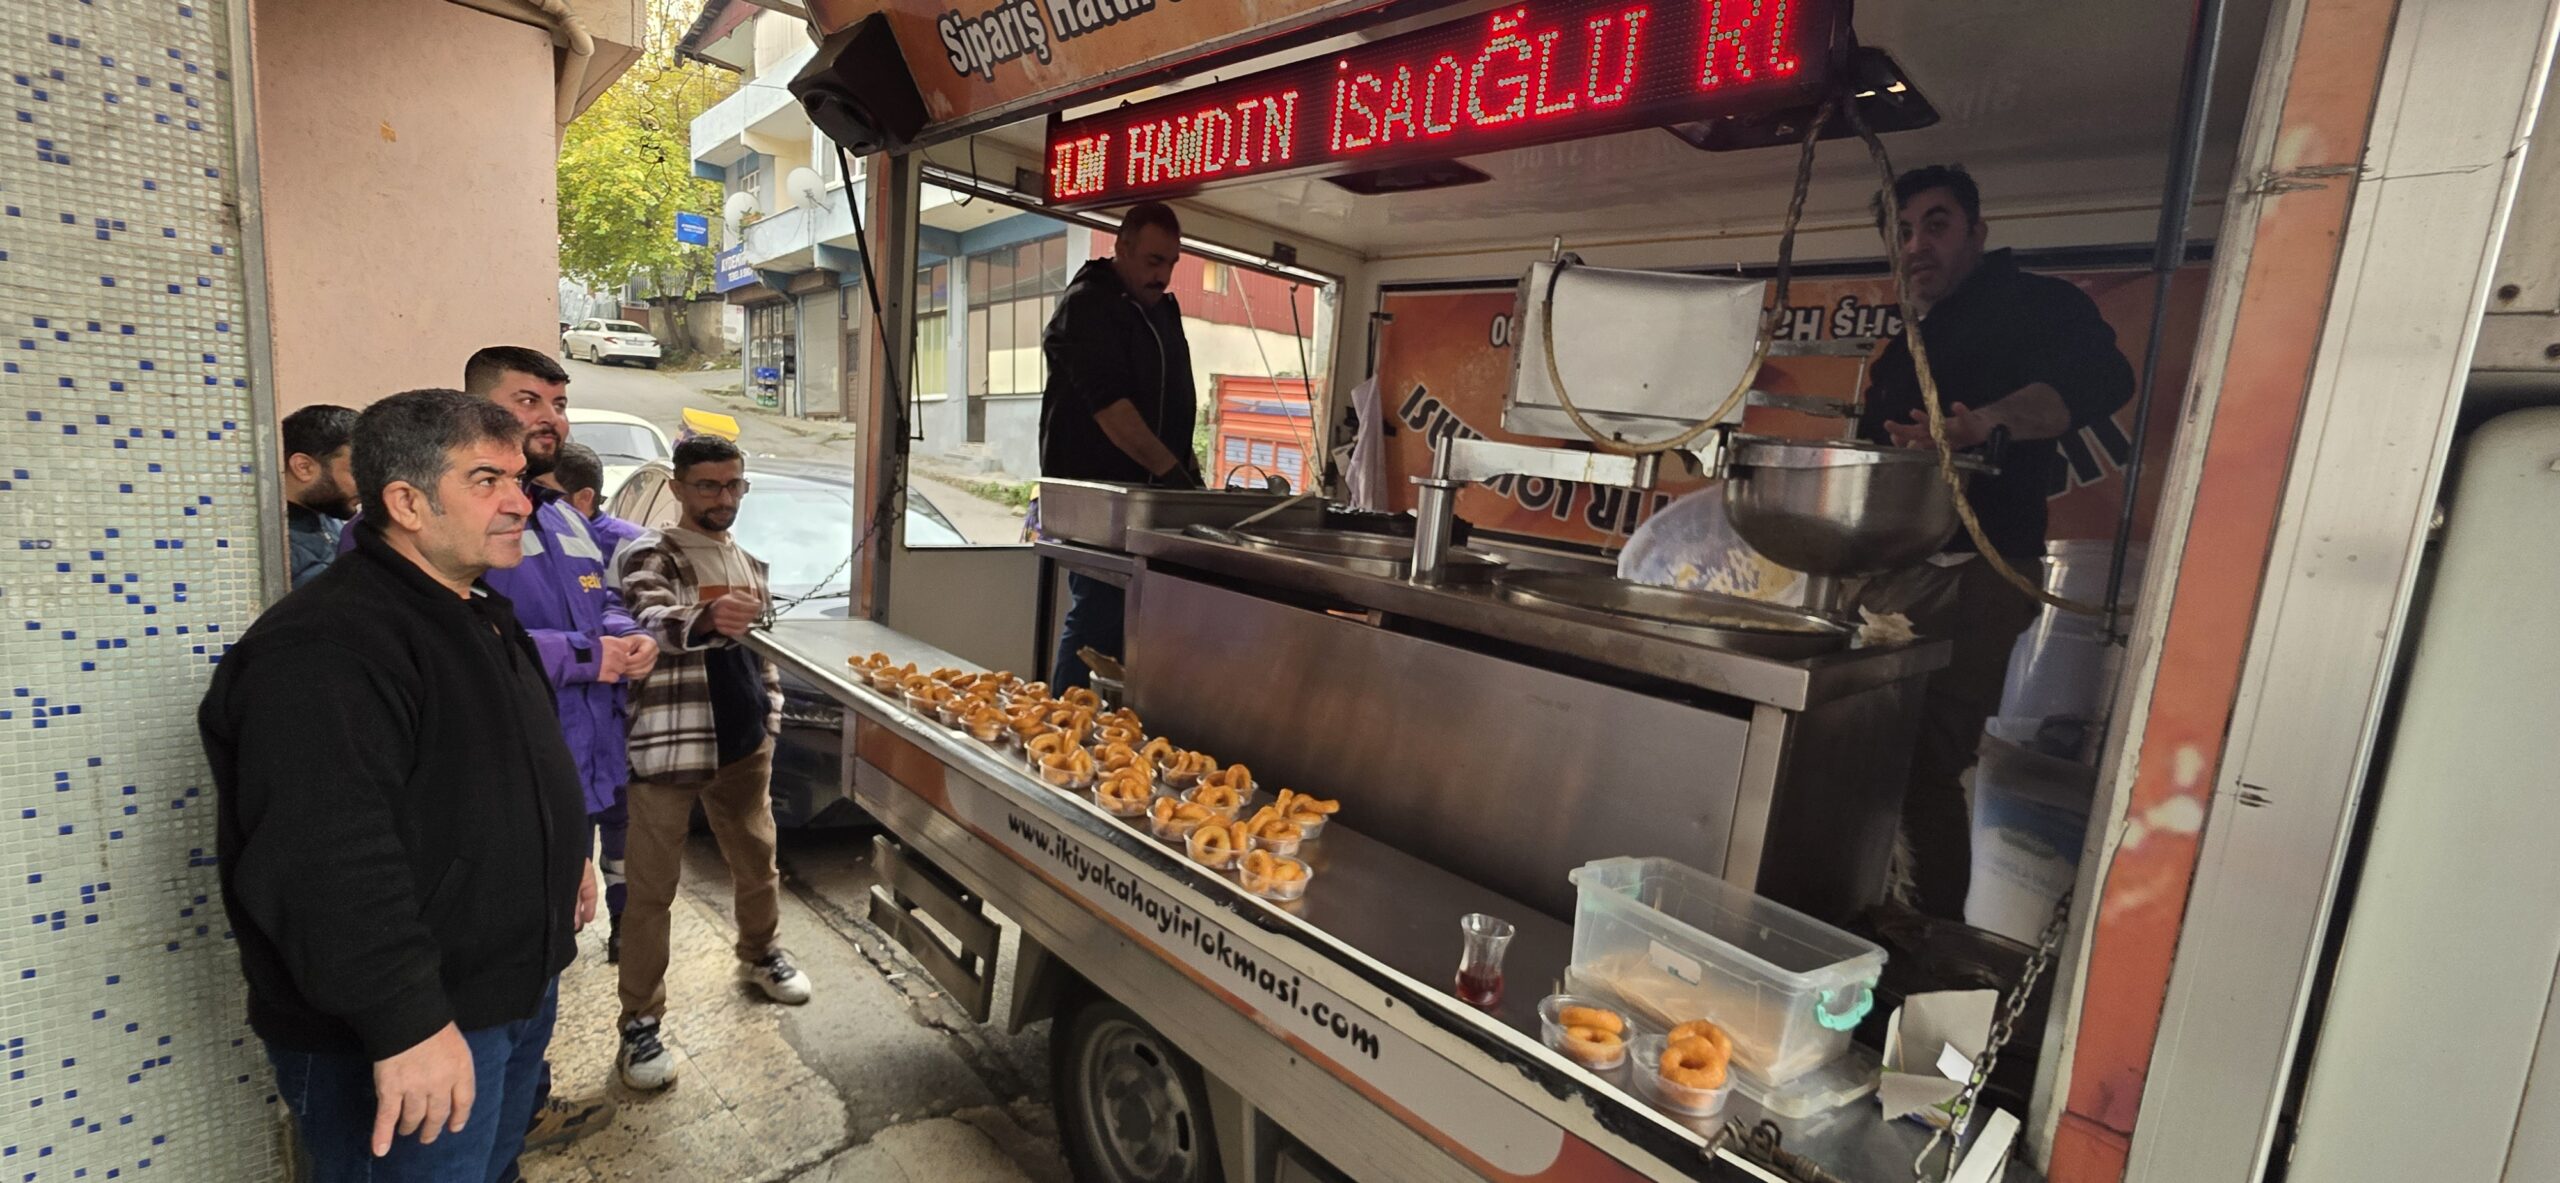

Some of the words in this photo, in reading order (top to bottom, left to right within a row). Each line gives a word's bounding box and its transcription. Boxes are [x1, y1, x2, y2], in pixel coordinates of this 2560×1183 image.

[938, 0, 1050, 80] Sipariş
[1330, 8, 1649, 152] İSAOĞLU
[1008, 812, 1381, 1060] www.ikiyakahayirlokmasi.com
